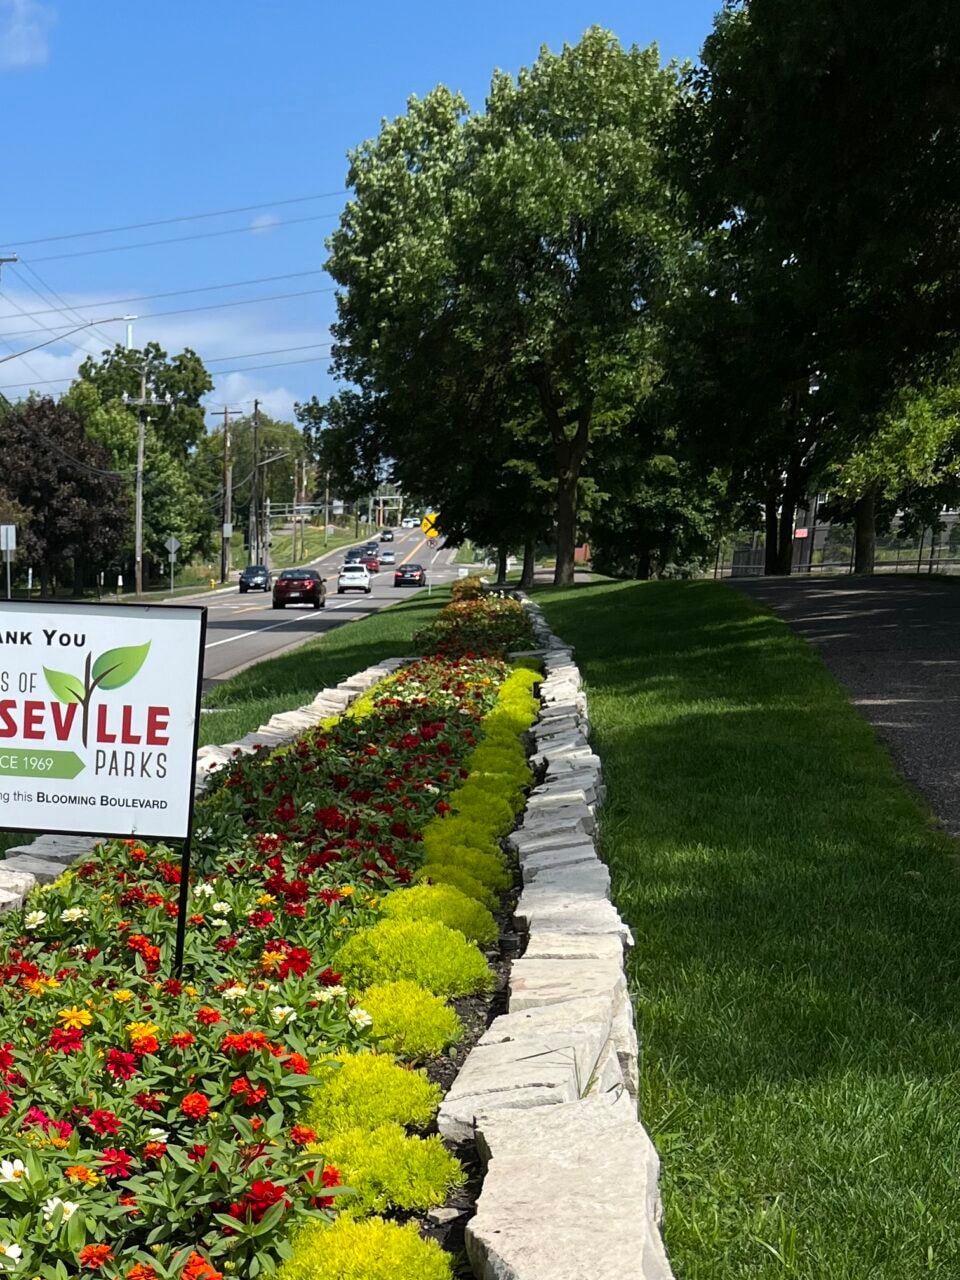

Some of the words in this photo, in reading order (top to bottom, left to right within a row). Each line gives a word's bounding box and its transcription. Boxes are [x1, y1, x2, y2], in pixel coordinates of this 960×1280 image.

[43, 629, 86, 648] YOU
[18, 671, 38, 694] OF
[23, 756, 54, 771] 1969
[95, 749, 168, 779] PARKS
[13, 790, 33, 803] this
[36, 791, 97, 806] BLOOMING
[99, 795, 168, 810] BOULEVARD
